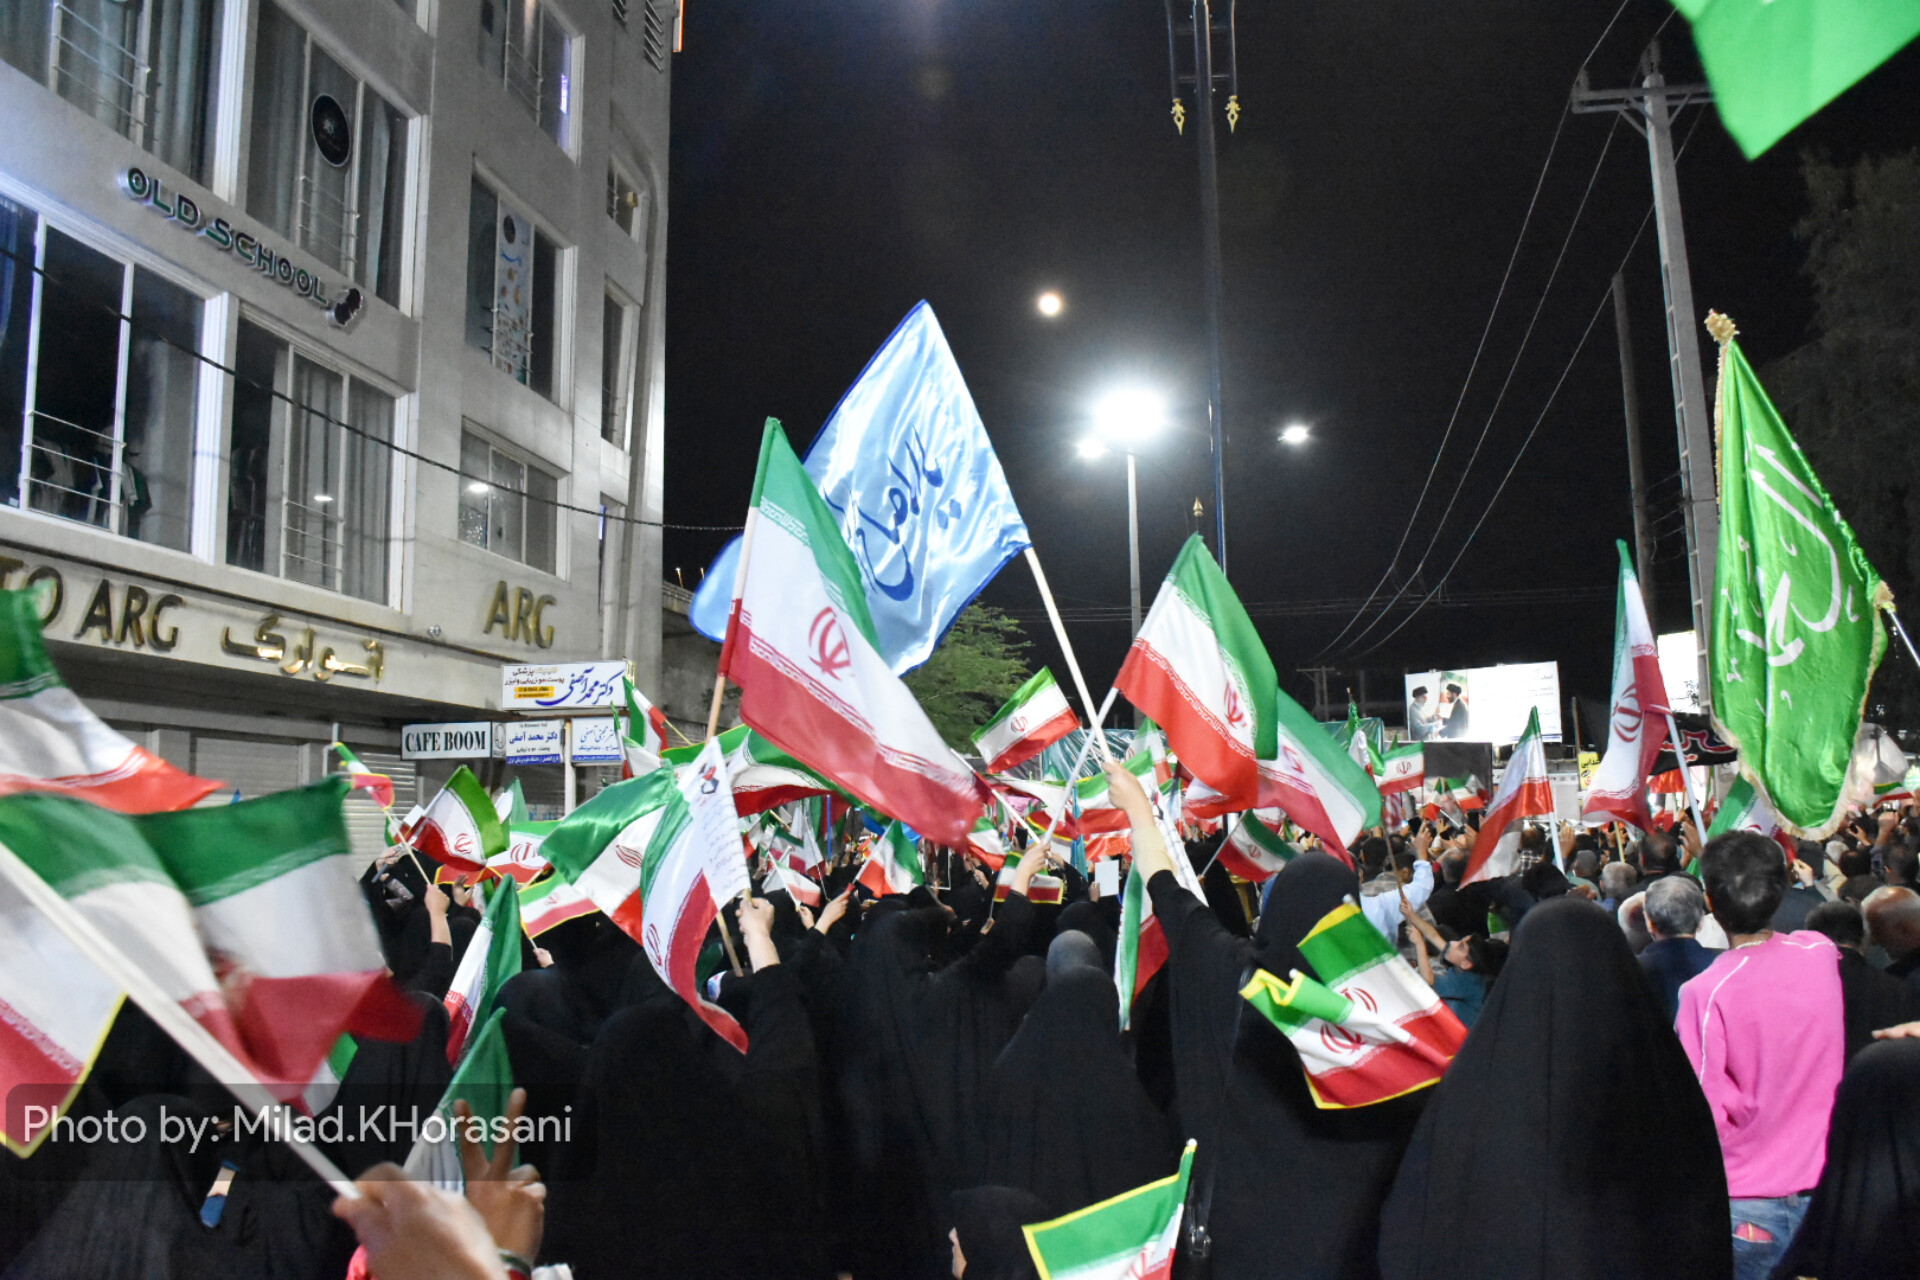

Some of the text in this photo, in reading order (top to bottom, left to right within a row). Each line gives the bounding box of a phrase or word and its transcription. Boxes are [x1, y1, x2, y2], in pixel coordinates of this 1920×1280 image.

[125, 167, 328, 306] OLD SCHOOL
[73, 578, 187, 652] ARG
[482, 580, 558, 650] ARG
[576, 680, 600, 705] محمد
[591, 669, 626, 706] دکتر
[404, 730, 486, 752] CAFE BOOM
